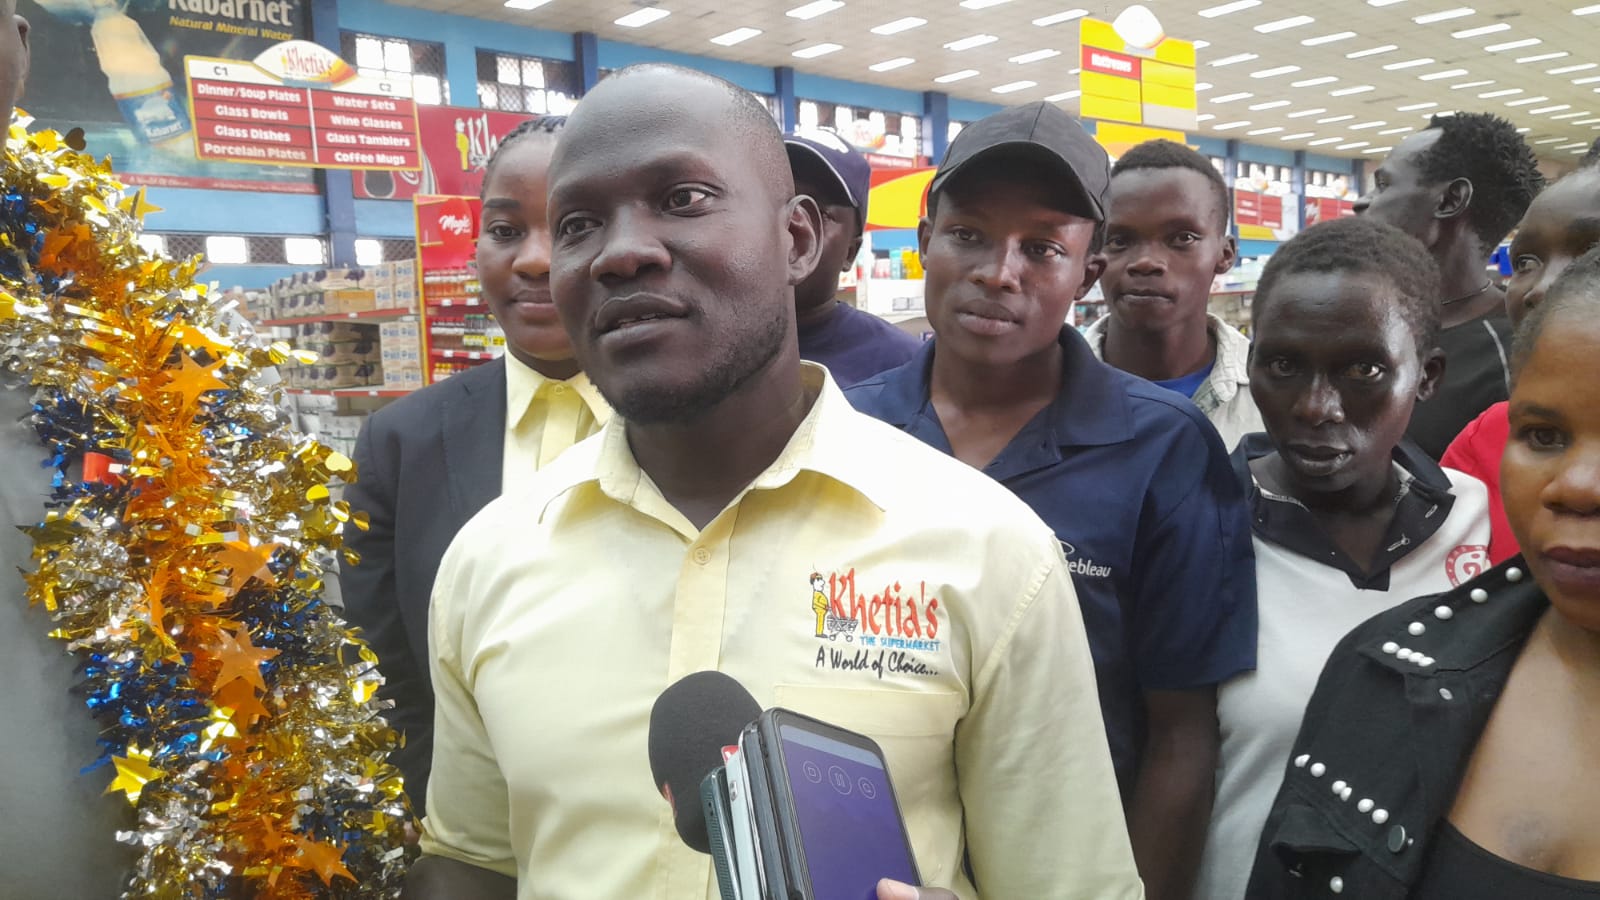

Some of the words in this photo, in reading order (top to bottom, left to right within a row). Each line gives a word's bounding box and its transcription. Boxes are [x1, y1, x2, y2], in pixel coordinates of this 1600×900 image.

[169, 16, 213, 31] Natural
[215, 22, 258, 37] Mineral
[261, 28, 293, 41] Water
[214, 65, 228, 76] C1
[198, 84, 267, 99] Dinner/Soup
[268, 89, 301, 102] Plates
[380, 82, 392, 92] C2
[333, 96, 369, 109] Water
[371, 99, 396, 111] Sets
[215, 106, 249, 118] Glass
[251, 108, 289, 121] Bowls
[331, 115, 360, 126] Wine
[362, 117, 404, 130] Glasses
[215, 126, 249, 138] Glass
[251, 129, 291, 142] Dishes
[327, 133, 357, 144] Glass
[204, 143, 266, 157] Porcelain
[267, 148, 307, 160] Plates
[335, 152, 374, 163] Coffee
[376, 154, 406, 166] Mugs
[1068, 557, 1112, 578] ebleau
[828, 567, 938, 639] Khetia's
[859, 635, 877, 647] THE
[880, 636, 941, 652] SUPERMARKET
[815, 645, 826, 668] A
[830, 647, 869, 670] World
[871, 650, 885, 679] of
